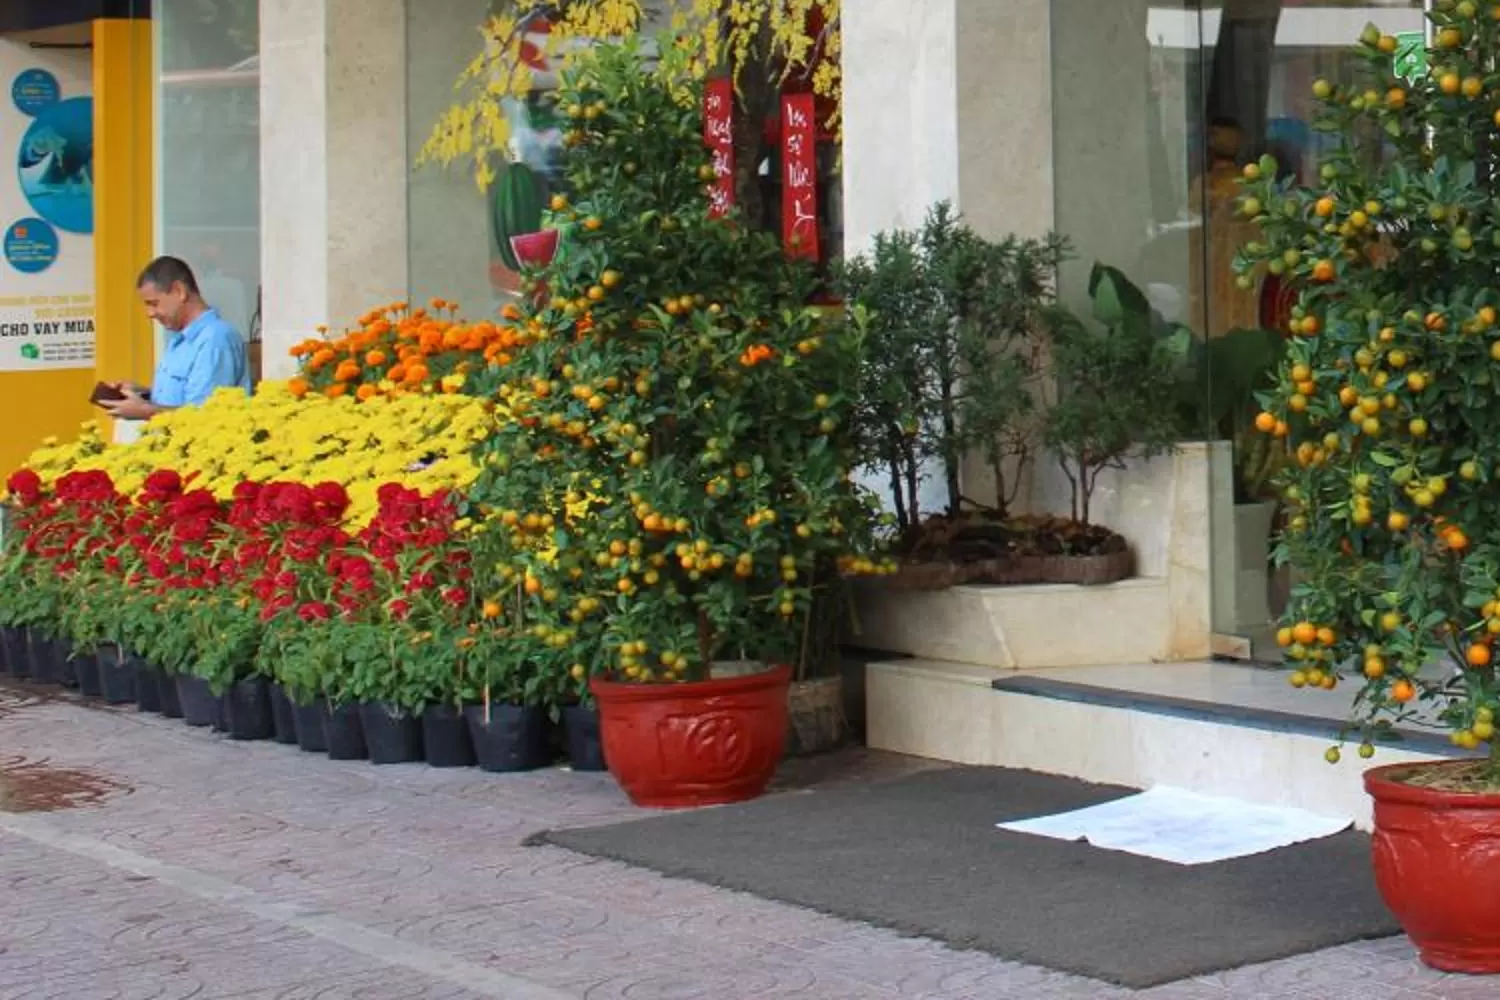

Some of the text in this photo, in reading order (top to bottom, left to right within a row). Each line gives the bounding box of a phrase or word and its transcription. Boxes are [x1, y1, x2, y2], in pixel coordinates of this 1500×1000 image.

[1, 319, 95, 337] CHO VAY MUA
